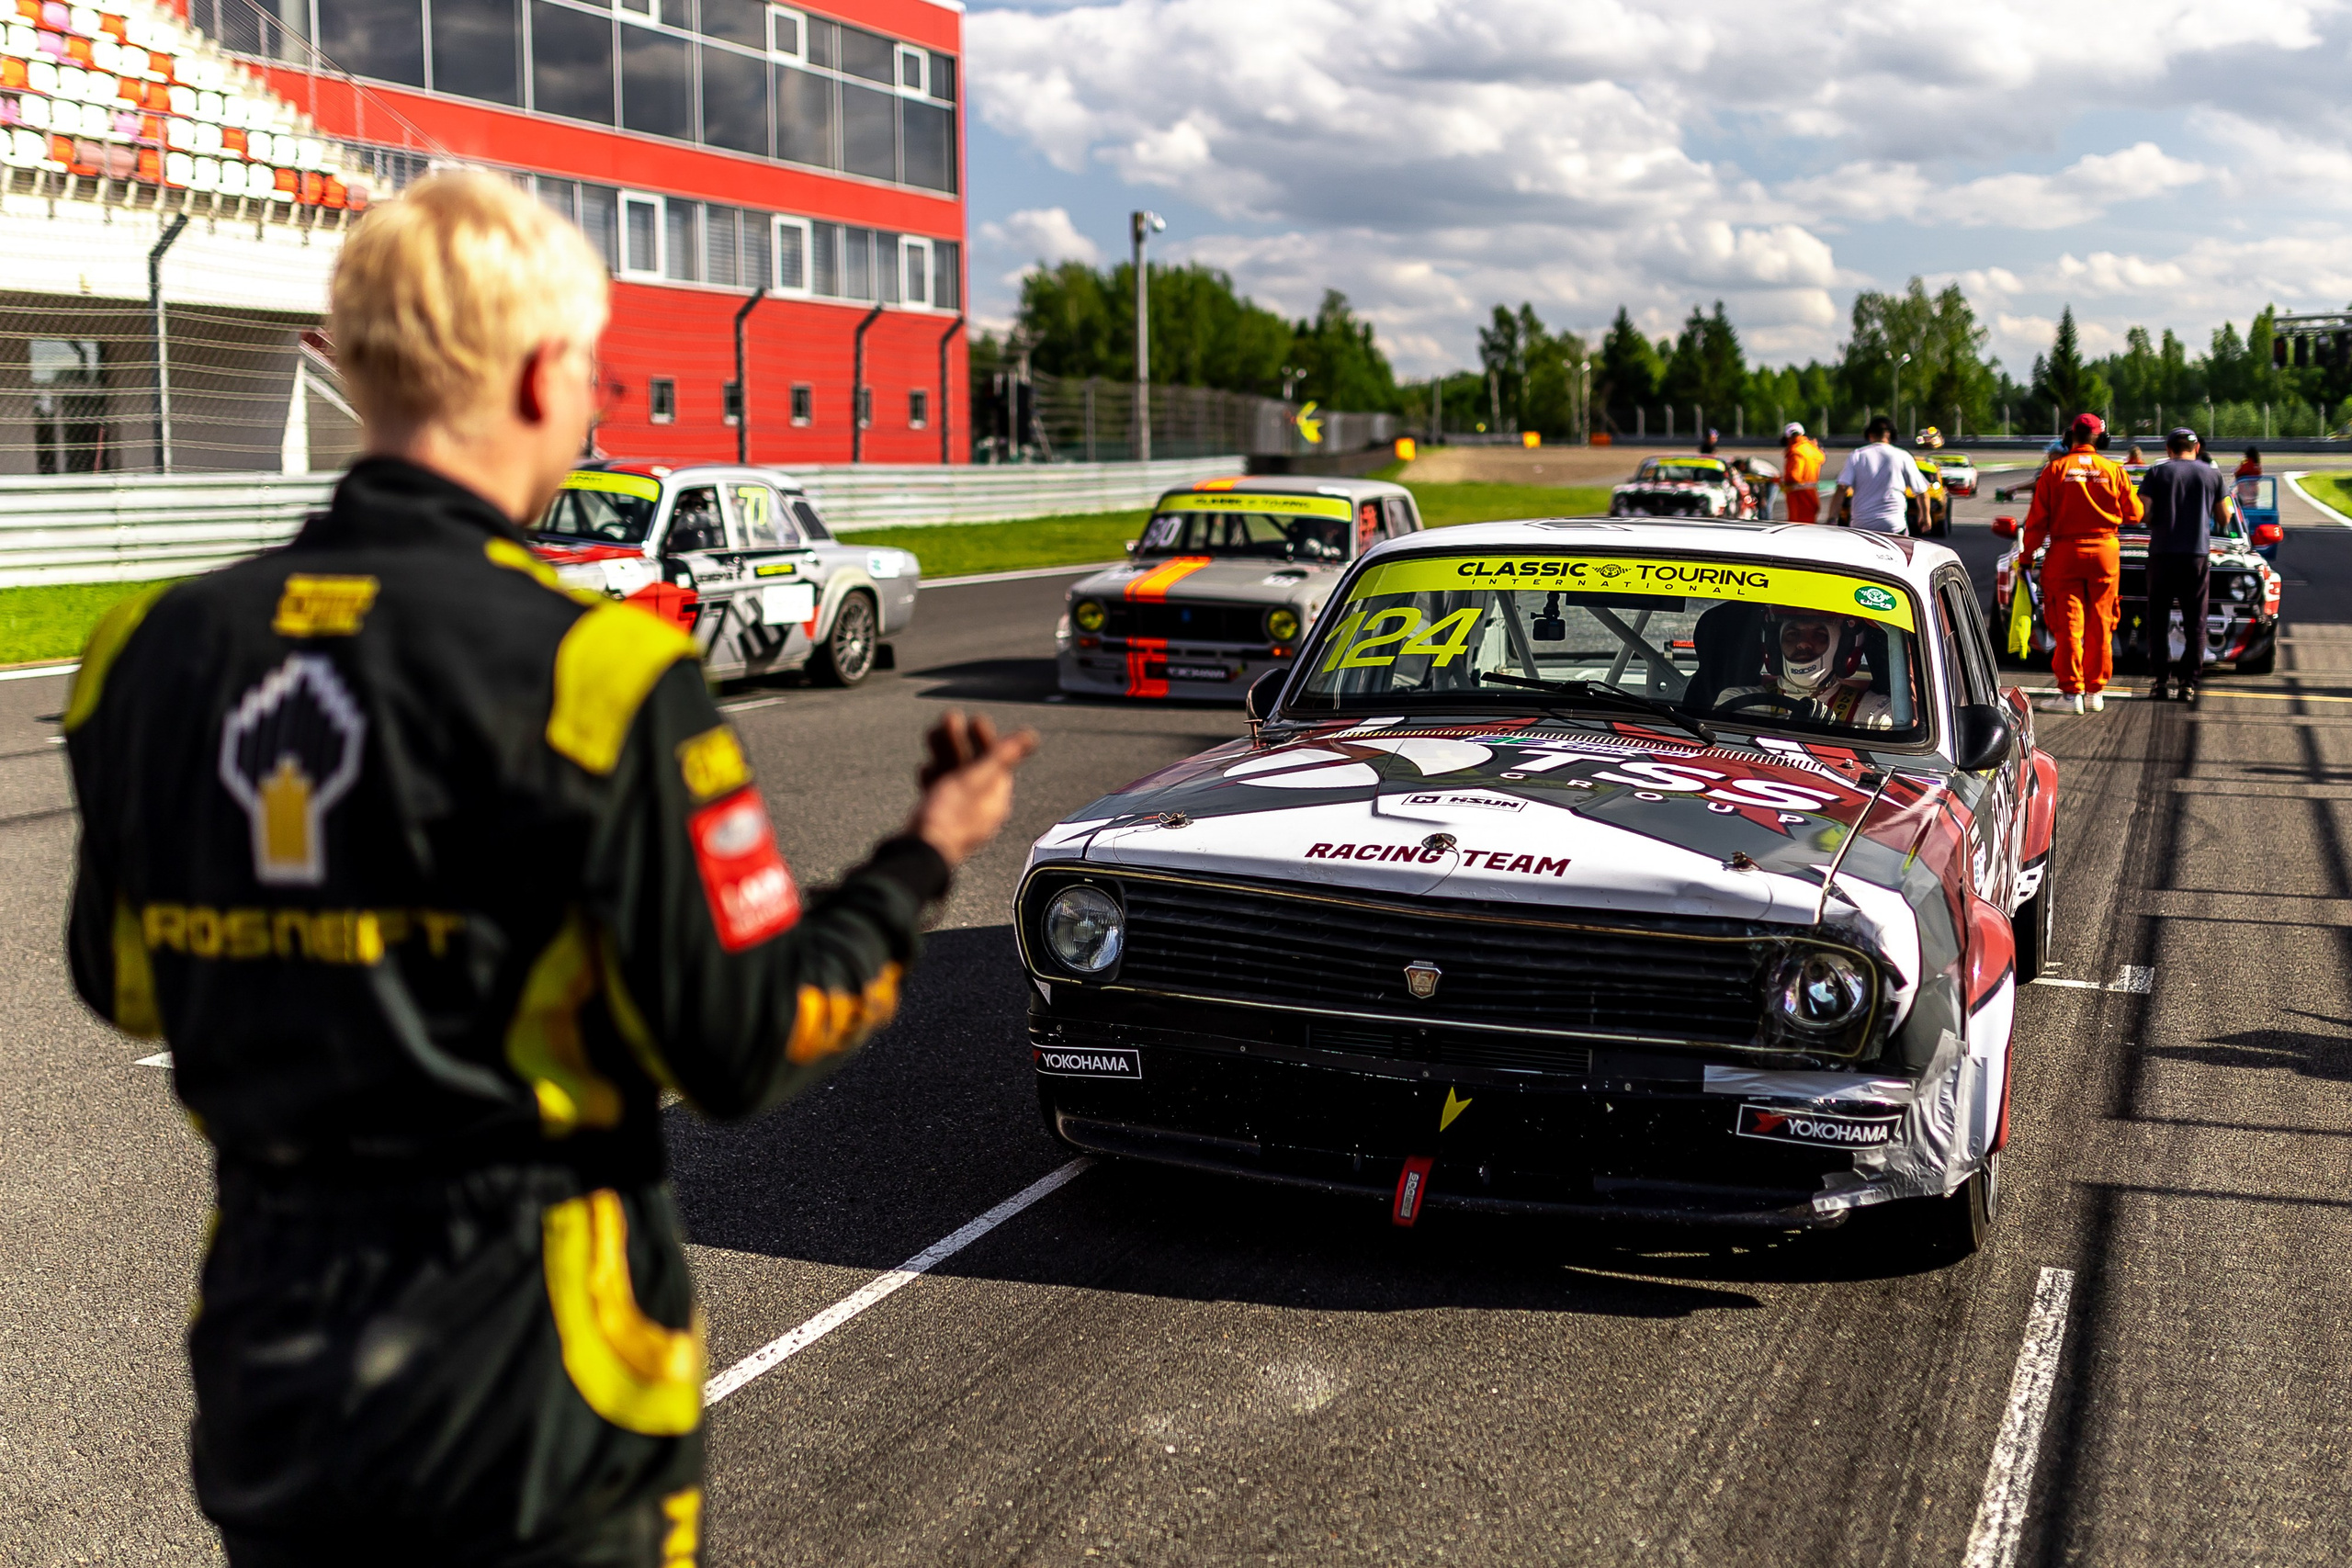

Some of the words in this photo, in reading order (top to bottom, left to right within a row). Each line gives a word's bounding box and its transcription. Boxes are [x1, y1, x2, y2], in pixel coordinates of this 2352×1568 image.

[1457, 561, 1589, 577] CLASSIC
[1636, 564, 1770, 589] TOURING
[1471, 578, 1746, 596] INTERNATIONAL
[1323, 607, 1483, 673] 124
[1510, 749, 1840, 812] TSS
[1499, 772, 1806, 826] GROUP
[1305, 842, 1446, 864] RACING
[1462, 849, 1572, 878] TEAM
[1042, 1052, 1130, 1072] YOKOHAMA
[1787, 1113, 1888, 1143] YOKOHAMA
